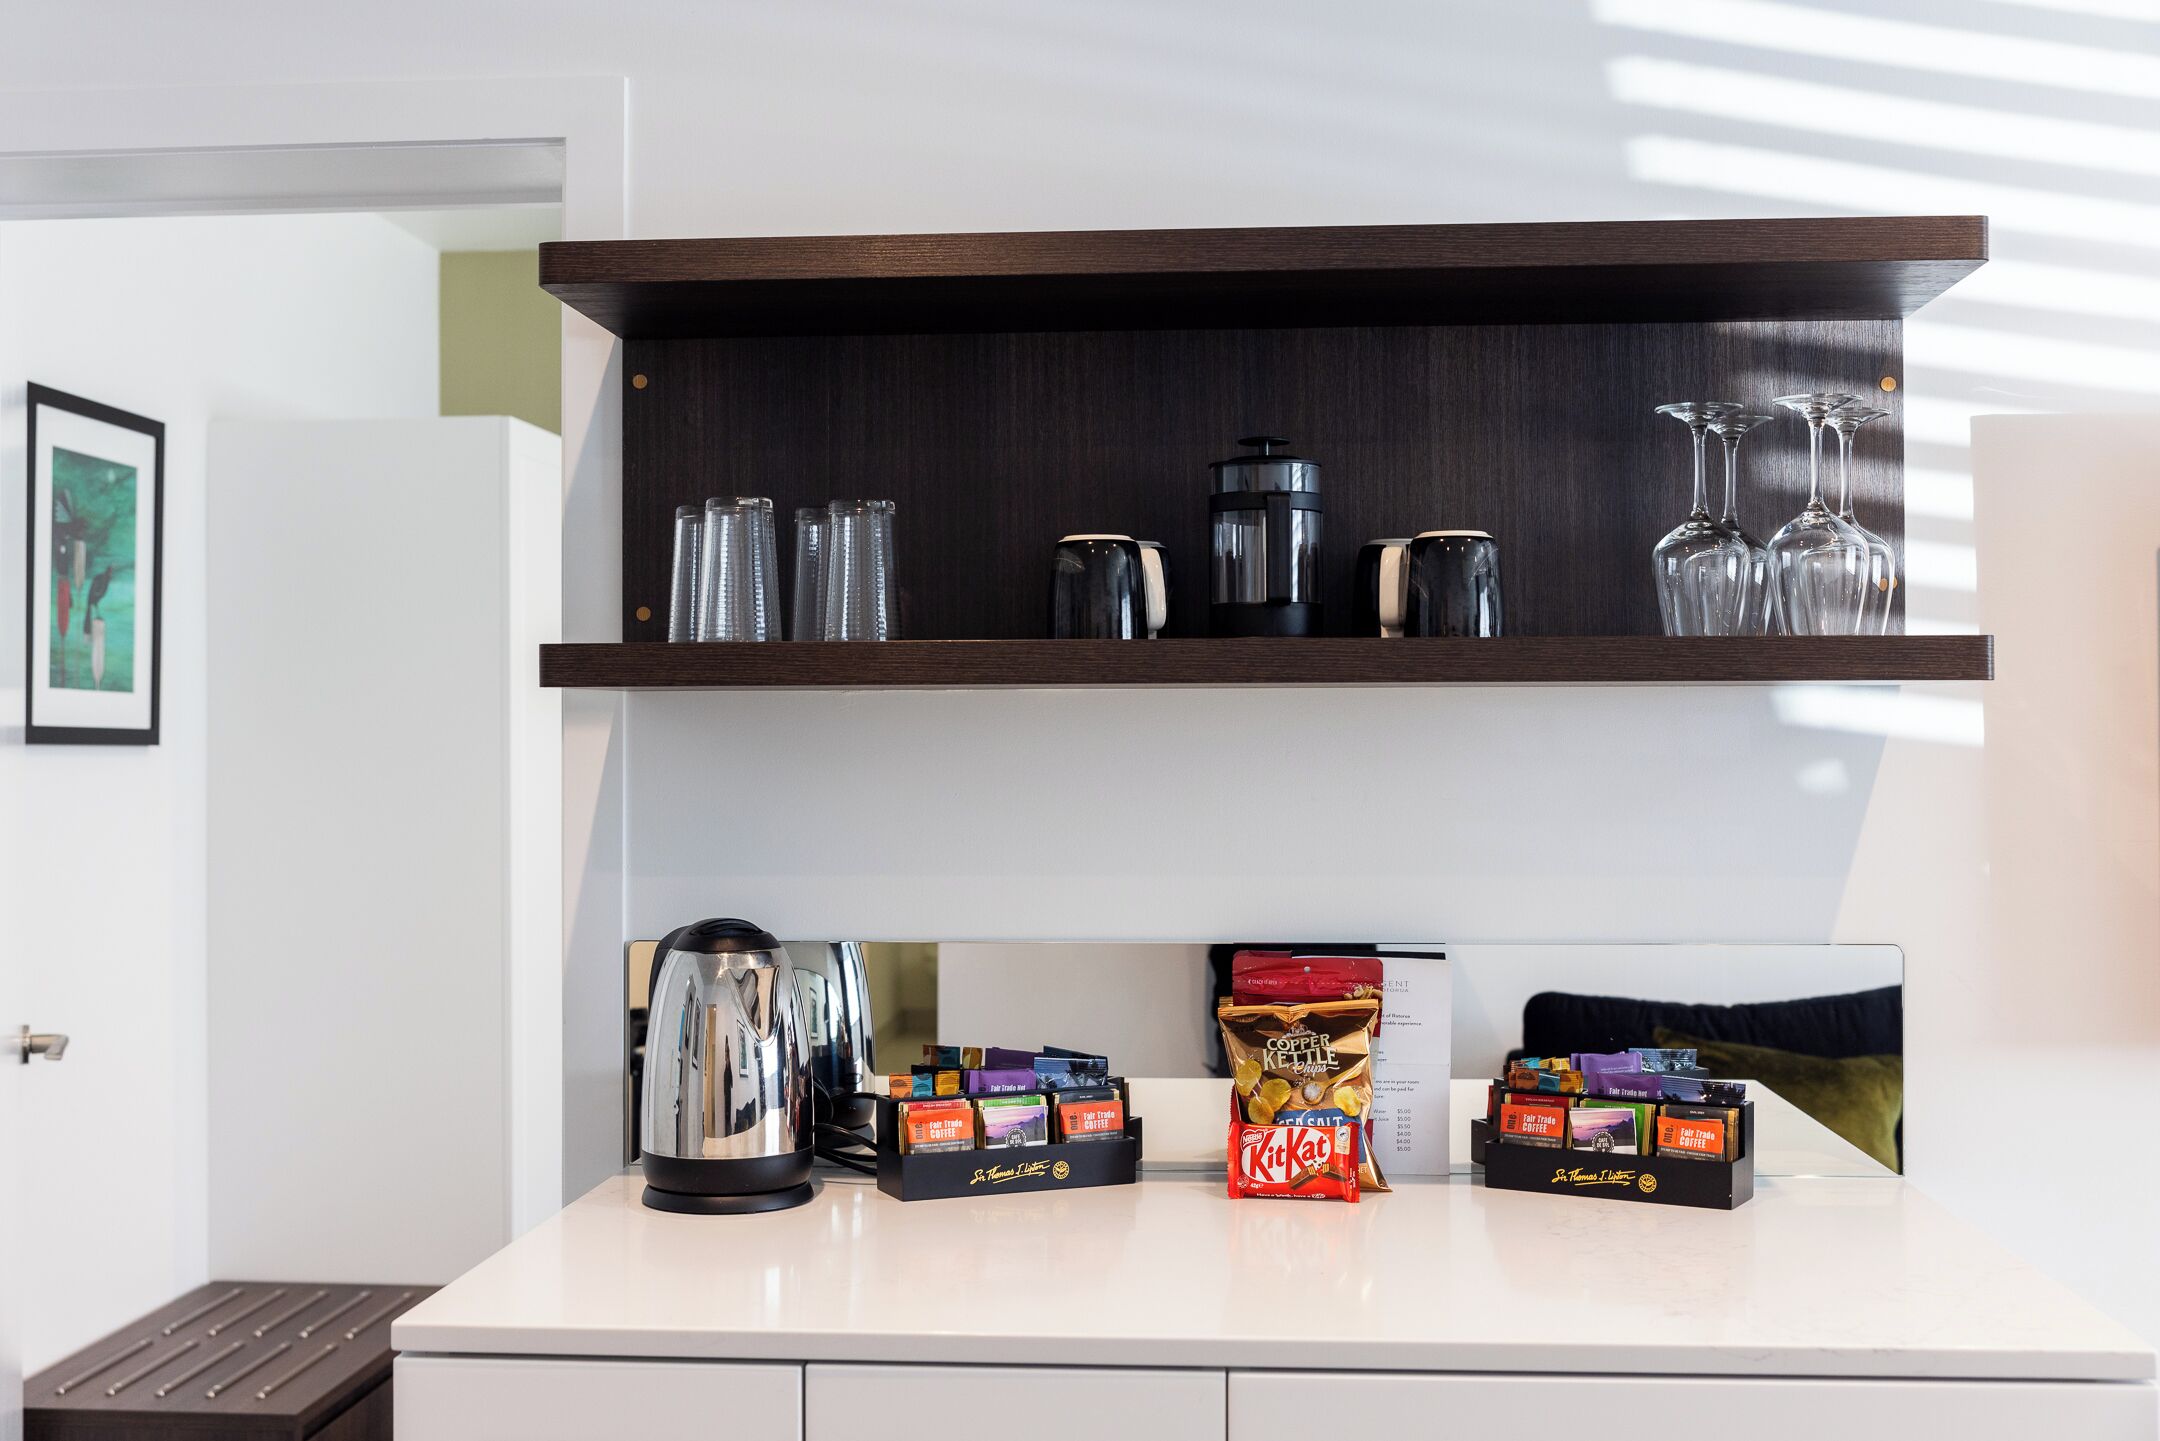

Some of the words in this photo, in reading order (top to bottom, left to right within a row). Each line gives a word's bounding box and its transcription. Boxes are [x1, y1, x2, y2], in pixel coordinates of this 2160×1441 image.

[1266, 1033, 1330, 1051] COPPER
[1262, 1047, 1339, 1071] KETTLE
[1288, 1061, 1339, 1077] Chips
[991, 1084, 1001, 1092] Fair
[1001, 1084, 1016, 1092] Trade
[1609, 1087, 1620, 1095] Fair
[1621, 1088, 1637, 1097] Trade
[1084, 1111, 1095, 1120] Fair
[1097, 1110, 1115, 1119] Trade
[1523, 1114, 1536, 1123] Fair
[1537, 1115, 1556, 1125] Trade
[930, 1120, 942, 1129] Fair
[944, 1119, 963, 1129] Trade
[1084, 1119, 1109, 1130] COFFEE
[1307, 1116, 1344, 1127] SALT
[930, 1128, 956, 1139] COFFEE
[1522, 1123, 1548, 1133] COFFEE
[1680, 1127, 1693, 1137] Fair
[1695, 1129, 1715, 1140] Trade
[1679, 1136, 1706, 1148] COFFEE
[1250, 1127, 1327, 1182] KitKat
[970, 1169, 986, 1185] Sir
[986, 1164, 1015, 1181] Thomas
[1024, 1160, 1050, 1176] Lipton
[1552, 1169, 1568, 1183] Sir
[1568, 1168, 1597, 1182] Thomas
[1608, 1170, 1635, 1184] Lipton
